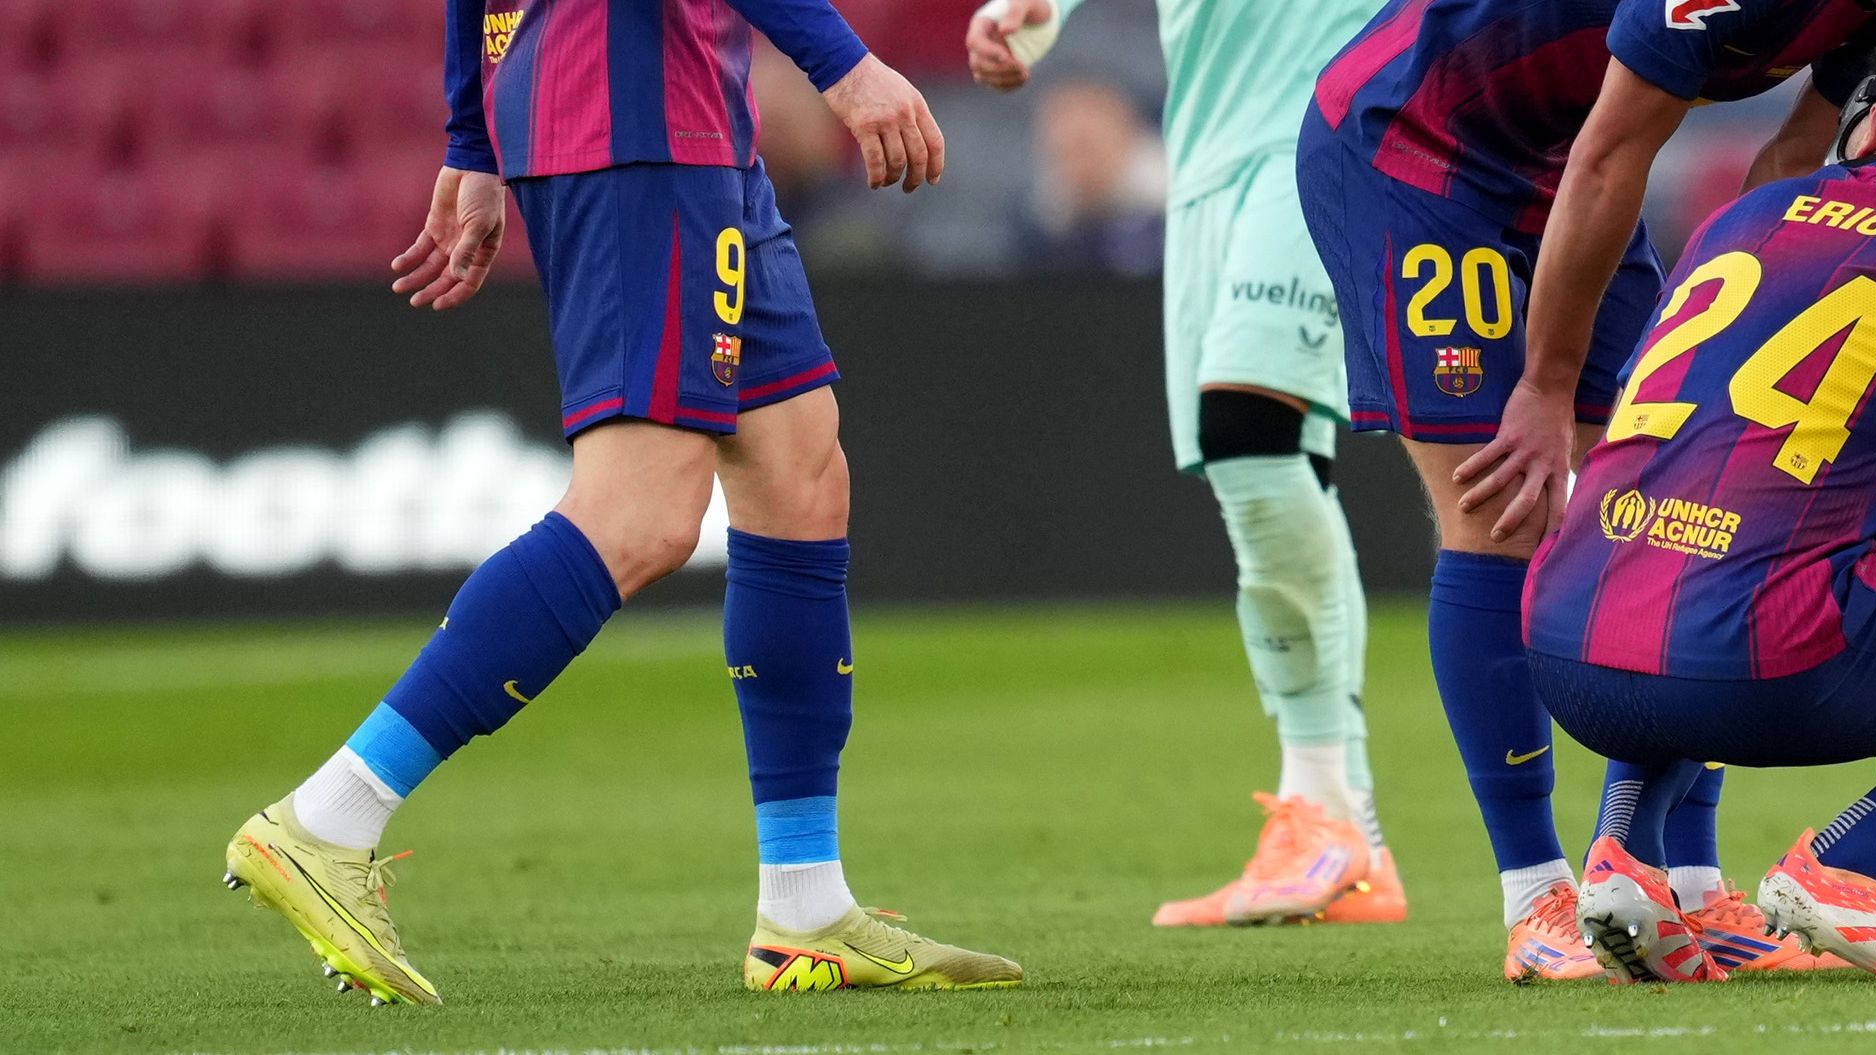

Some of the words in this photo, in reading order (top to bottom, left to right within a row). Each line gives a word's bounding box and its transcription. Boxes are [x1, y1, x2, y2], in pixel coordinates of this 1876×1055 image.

[713, 226, 745, 325] 9
[1401, 243, 1513, 339] 20
[1231, 276, 1338, 328] vueling
[1647, 517, 1733, 552] ACNUR
[1657, 498, 1742, 534] UNHCR
[1646, 537, 1660, 548] The
[1661, 540, 1671, 550] UN
[1672, 543, 1698, 556] Refugee
[1698, 547, 1725, 561] Agency
